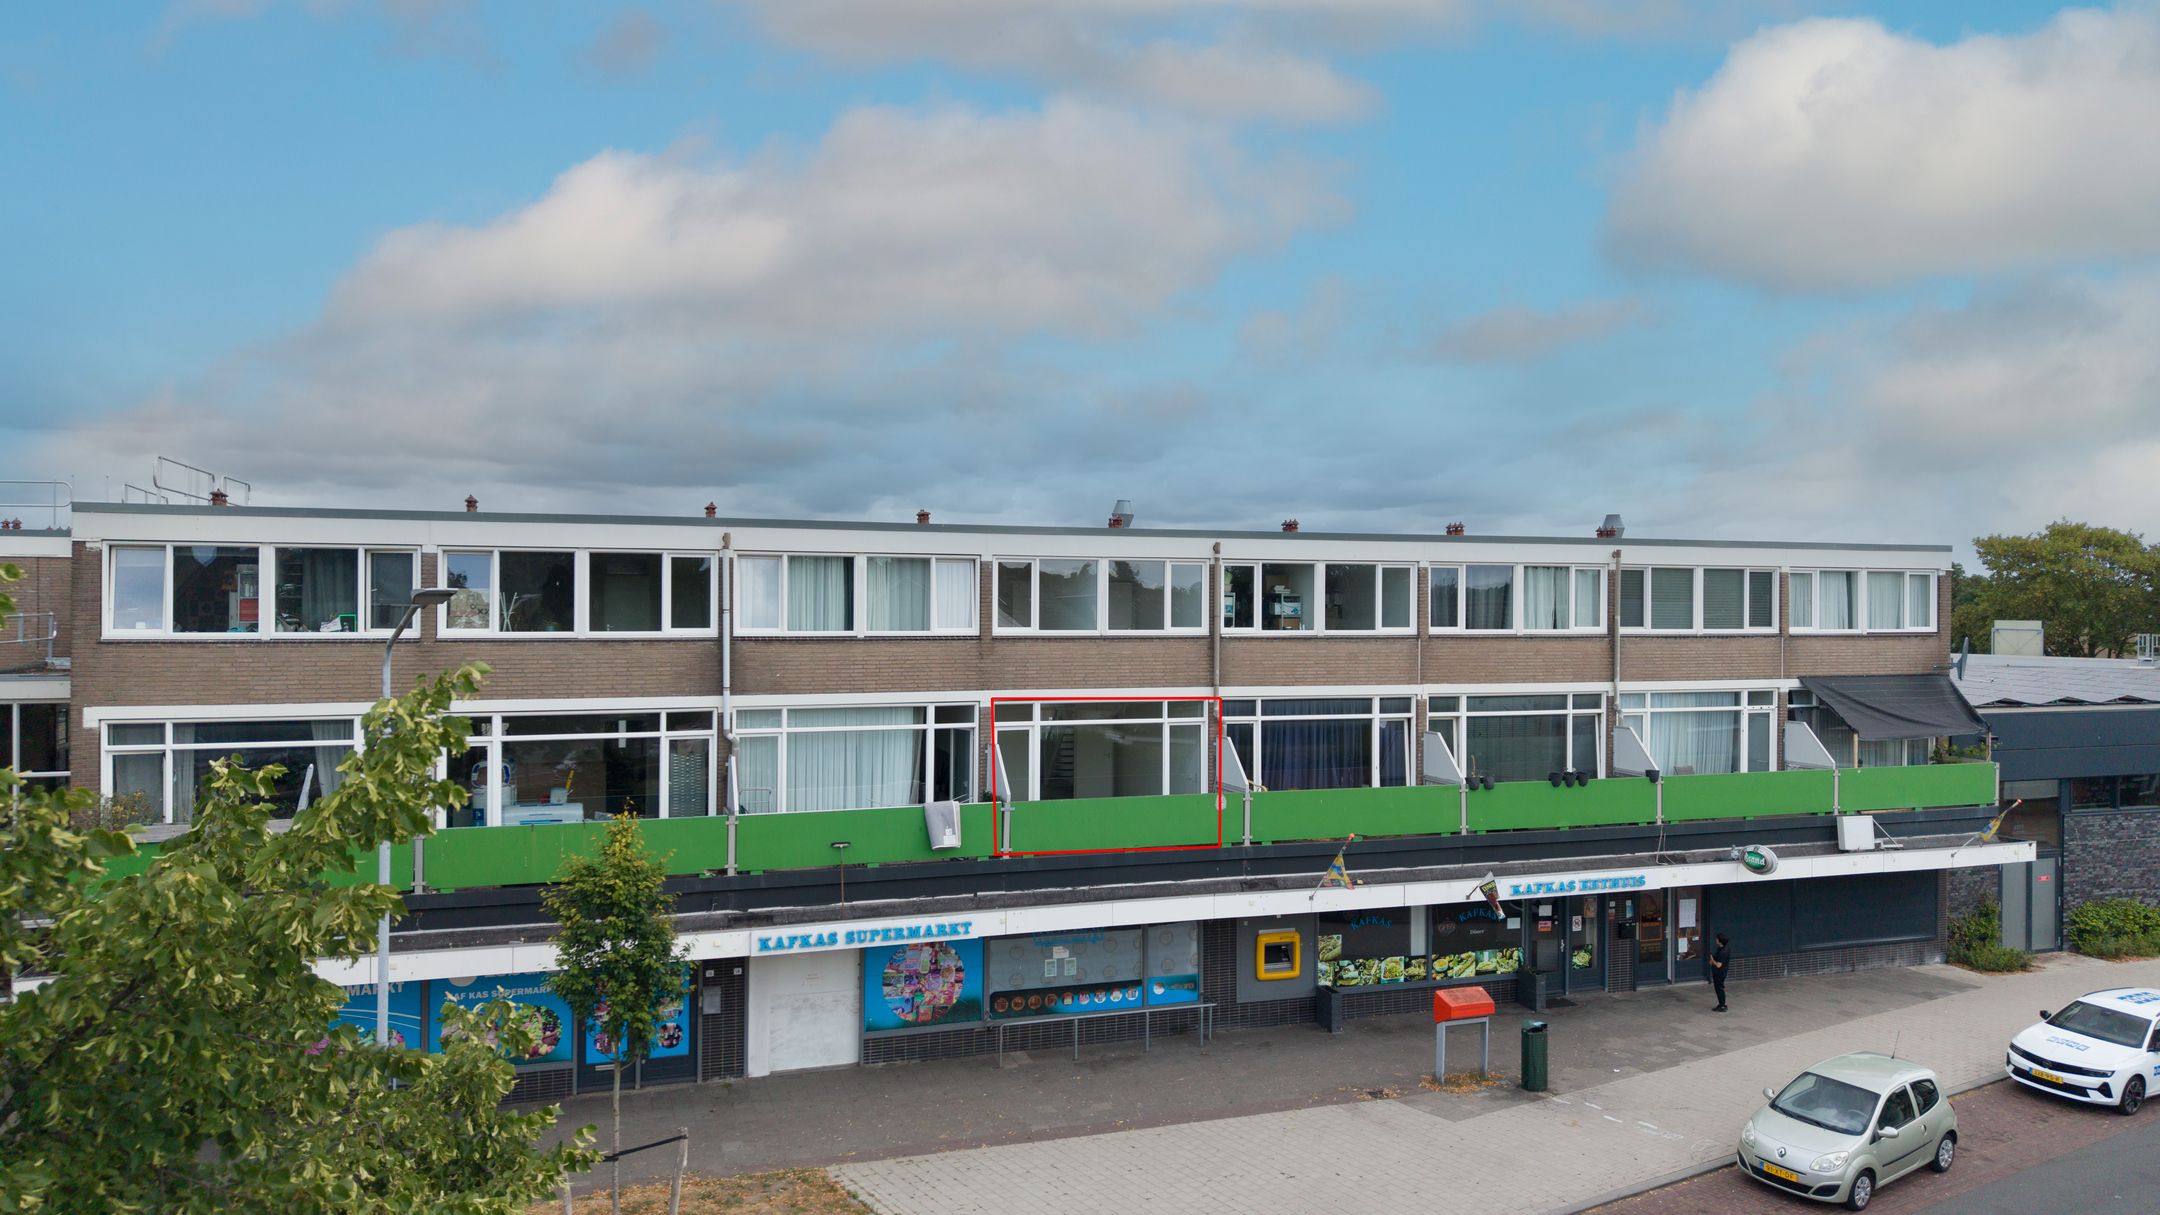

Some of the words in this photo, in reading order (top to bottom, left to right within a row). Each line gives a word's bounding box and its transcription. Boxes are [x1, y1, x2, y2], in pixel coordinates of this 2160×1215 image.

[1511, 880, 1576, 896] KAFKAS
[1579, 875, 1646, 891] EETHUIS
[759, 932, 838, 951] KAFKAS
[845, 922, 972, 944] SUPERMARKT
[468, 990, 489, 1000] KAS
[491, 985, 557, 999] SUPERMARK
